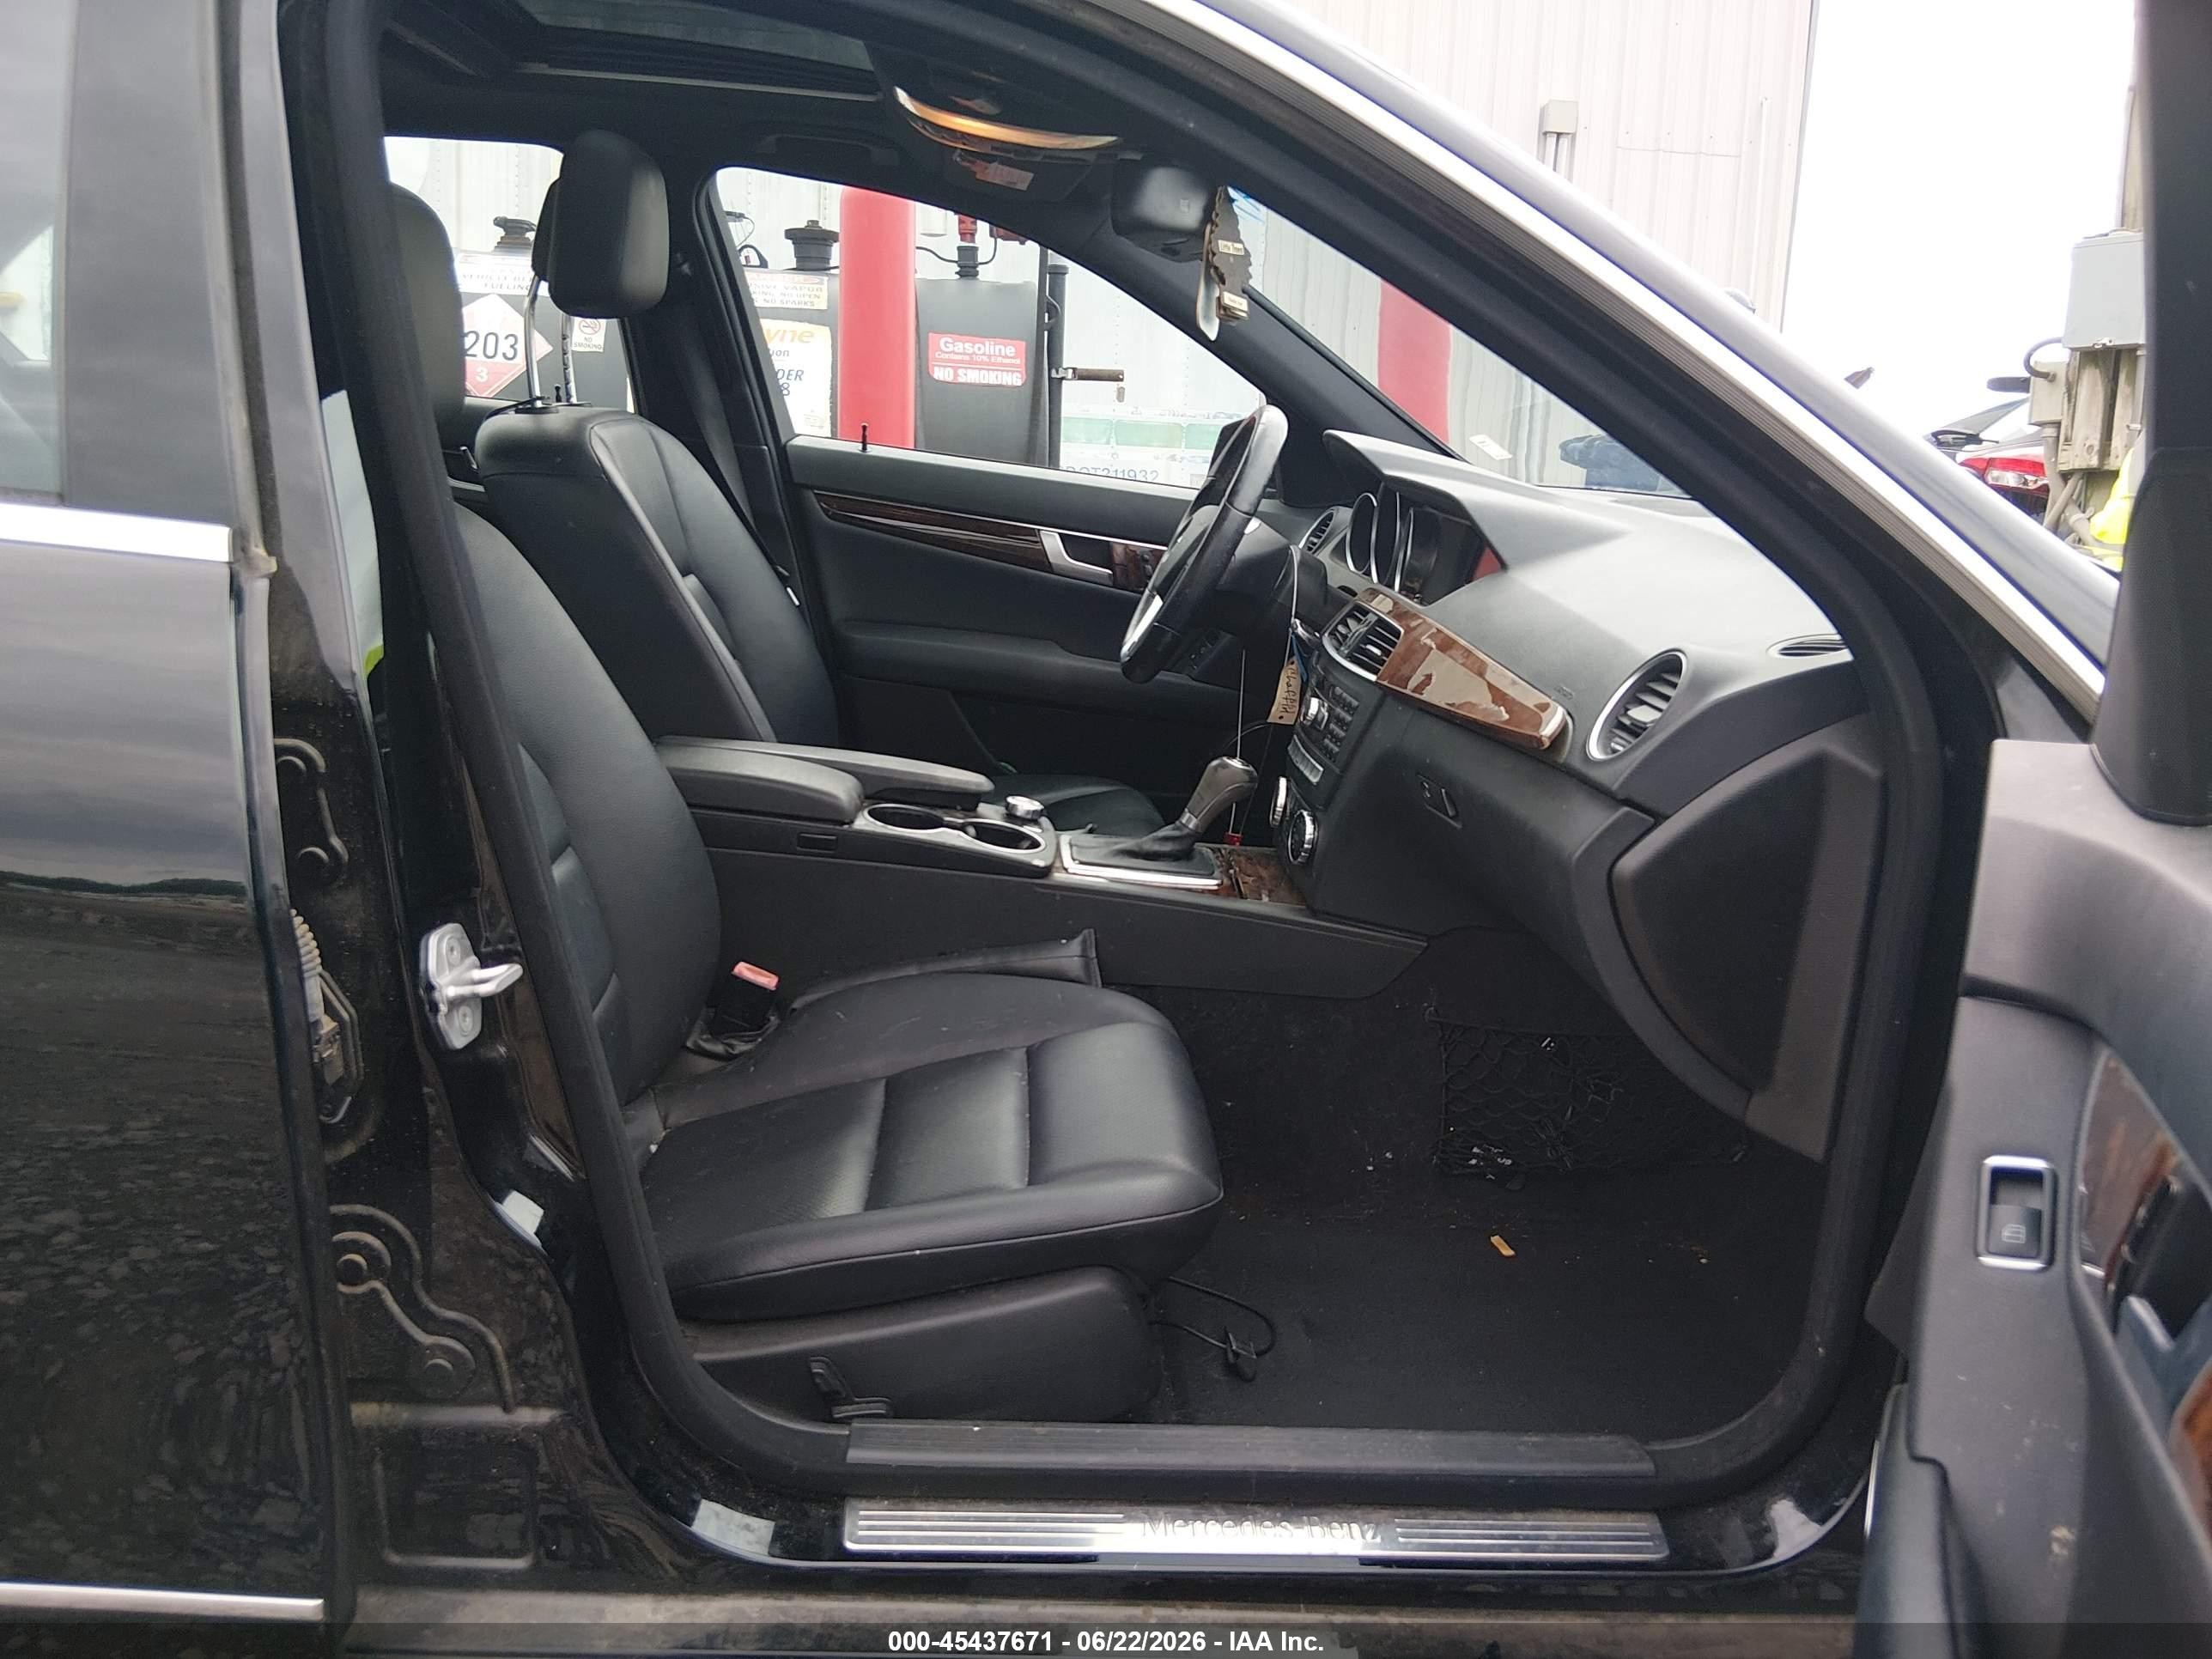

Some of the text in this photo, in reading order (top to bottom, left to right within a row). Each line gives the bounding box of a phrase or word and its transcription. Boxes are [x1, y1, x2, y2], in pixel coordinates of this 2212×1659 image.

[771, 348, 790, 357] ion
[939, 337, 1016, 357] Gasoline
[934, 351, 970, 362] Contains
[971, 354, 989, 362] 10%
[475, 367, 489, 383] 3
[933, 366, 1022, 386] NO SMOKING
[1141, 1510, 1382, 1540] Mercedes-Benz
